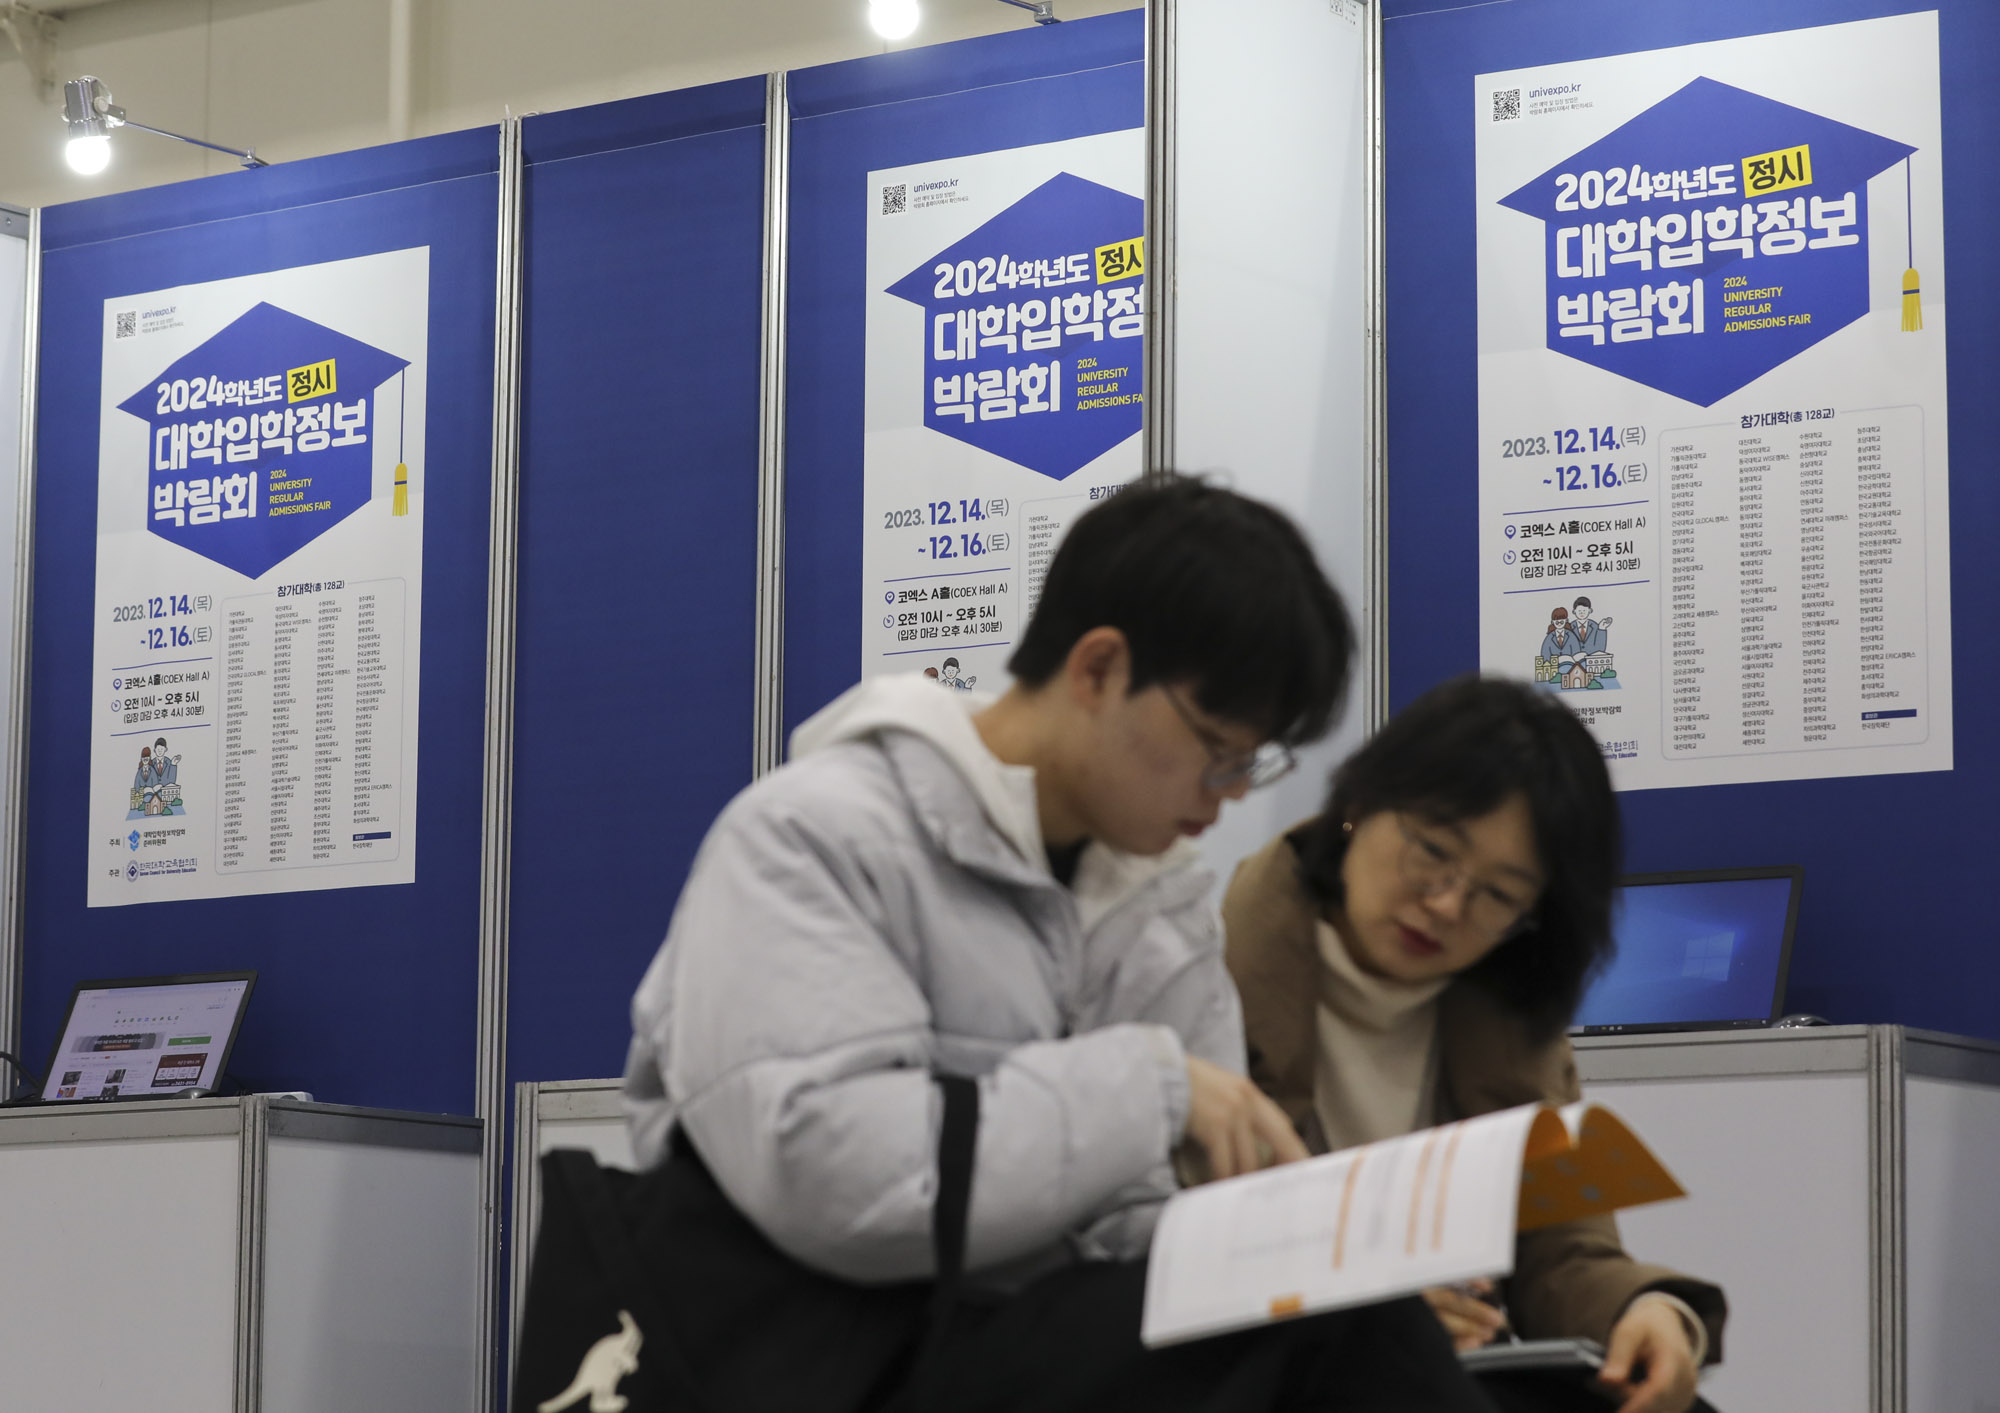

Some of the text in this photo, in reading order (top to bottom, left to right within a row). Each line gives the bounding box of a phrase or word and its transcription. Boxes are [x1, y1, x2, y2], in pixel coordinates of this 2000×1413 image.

[1529, 83, 1581, 98] univexpo.kr
[913, 178, 960, 193] univexpo.kr
[1554, 151, 1804, 212] 2024학년도 정시
[1556, 191, 1860, 279] 대학입학정보
[933, 253, 1090, 299] 2024학년도
[1724, 276, 1747, 288] 2024
[1724, 286, 1783, 303] UNIVERSITY
[1557, 277, 1705, 346] 박람회
[1724, 303, 1772, 318] REGULAR
[1724, 313, 1811, 333] ADMISSIONS FAIR
[1077, 358, 1097, 369] 2024
[1077, 367, 1128, 383] UNIVERSITY
[156, 364, 331, 416] 2024학년도 정시
[933, 360, 1061, 424] 박람회
[1077, 382, 1118, 397] REGULAR
[1077, 395, 1131, 411] ADMISSIONS
[1741, 408, 1835, 429] 참가대학(총 128교)
[155, 398, 367, 471] 대학입학정보
[270, 469, 287, 480] 2024
[269, 478, 312, 492] UNIVERSITY
[154, 471, 257, 527] 박람회
[269, 492, 304, 504] REGULAR
[269, 501, 331, 517] ADMISSIONS FAIR
[1520, 523, 1555, 539] 코엑스
[1614, 518, 1633, 530] Hall
[1635, 516, 1646, 529] A)
[1520, 548, 1544, 564] 오전
[1547, 545, 1572, 561] 10시
[1586, 543, 1612, 558] 오후
[1615, 541, 1634, 555] 5시
[1520, 557, 1641, 579] (입장 마감 오후 4시 30분)
[323, 580, 345, 591] 128교)
[898, 590, 928, 604] 코엑스
[979, 584, 996, 596] Hall
[998, 582, 1008, 594] A)
[898, 611, 918, 627] 오전
[920, 610, 943, 625] 10시
[956, 607, 977, 622] 오후
[979, 605, 996, 619] 5시
[897, 621, 1003, 642] (입장 마감 오후 4시 30분)
[124, 677, 146, 690] 코엑스
[185, 672, 199, 682] Hall
[201, 671, 210, 681] A)
[124, 697, 139, 711] 오전
[140, 695, 155, 708] 10시
[165, 692, 182, 705] 오후
[185, 691, 200, 703] 5시
[140, 710, 152, 722] 마감
[153, 708, 169, 719] 오후
[170, 707, 184, 717] 4시
[185, 705, 204, 716] 30분)
